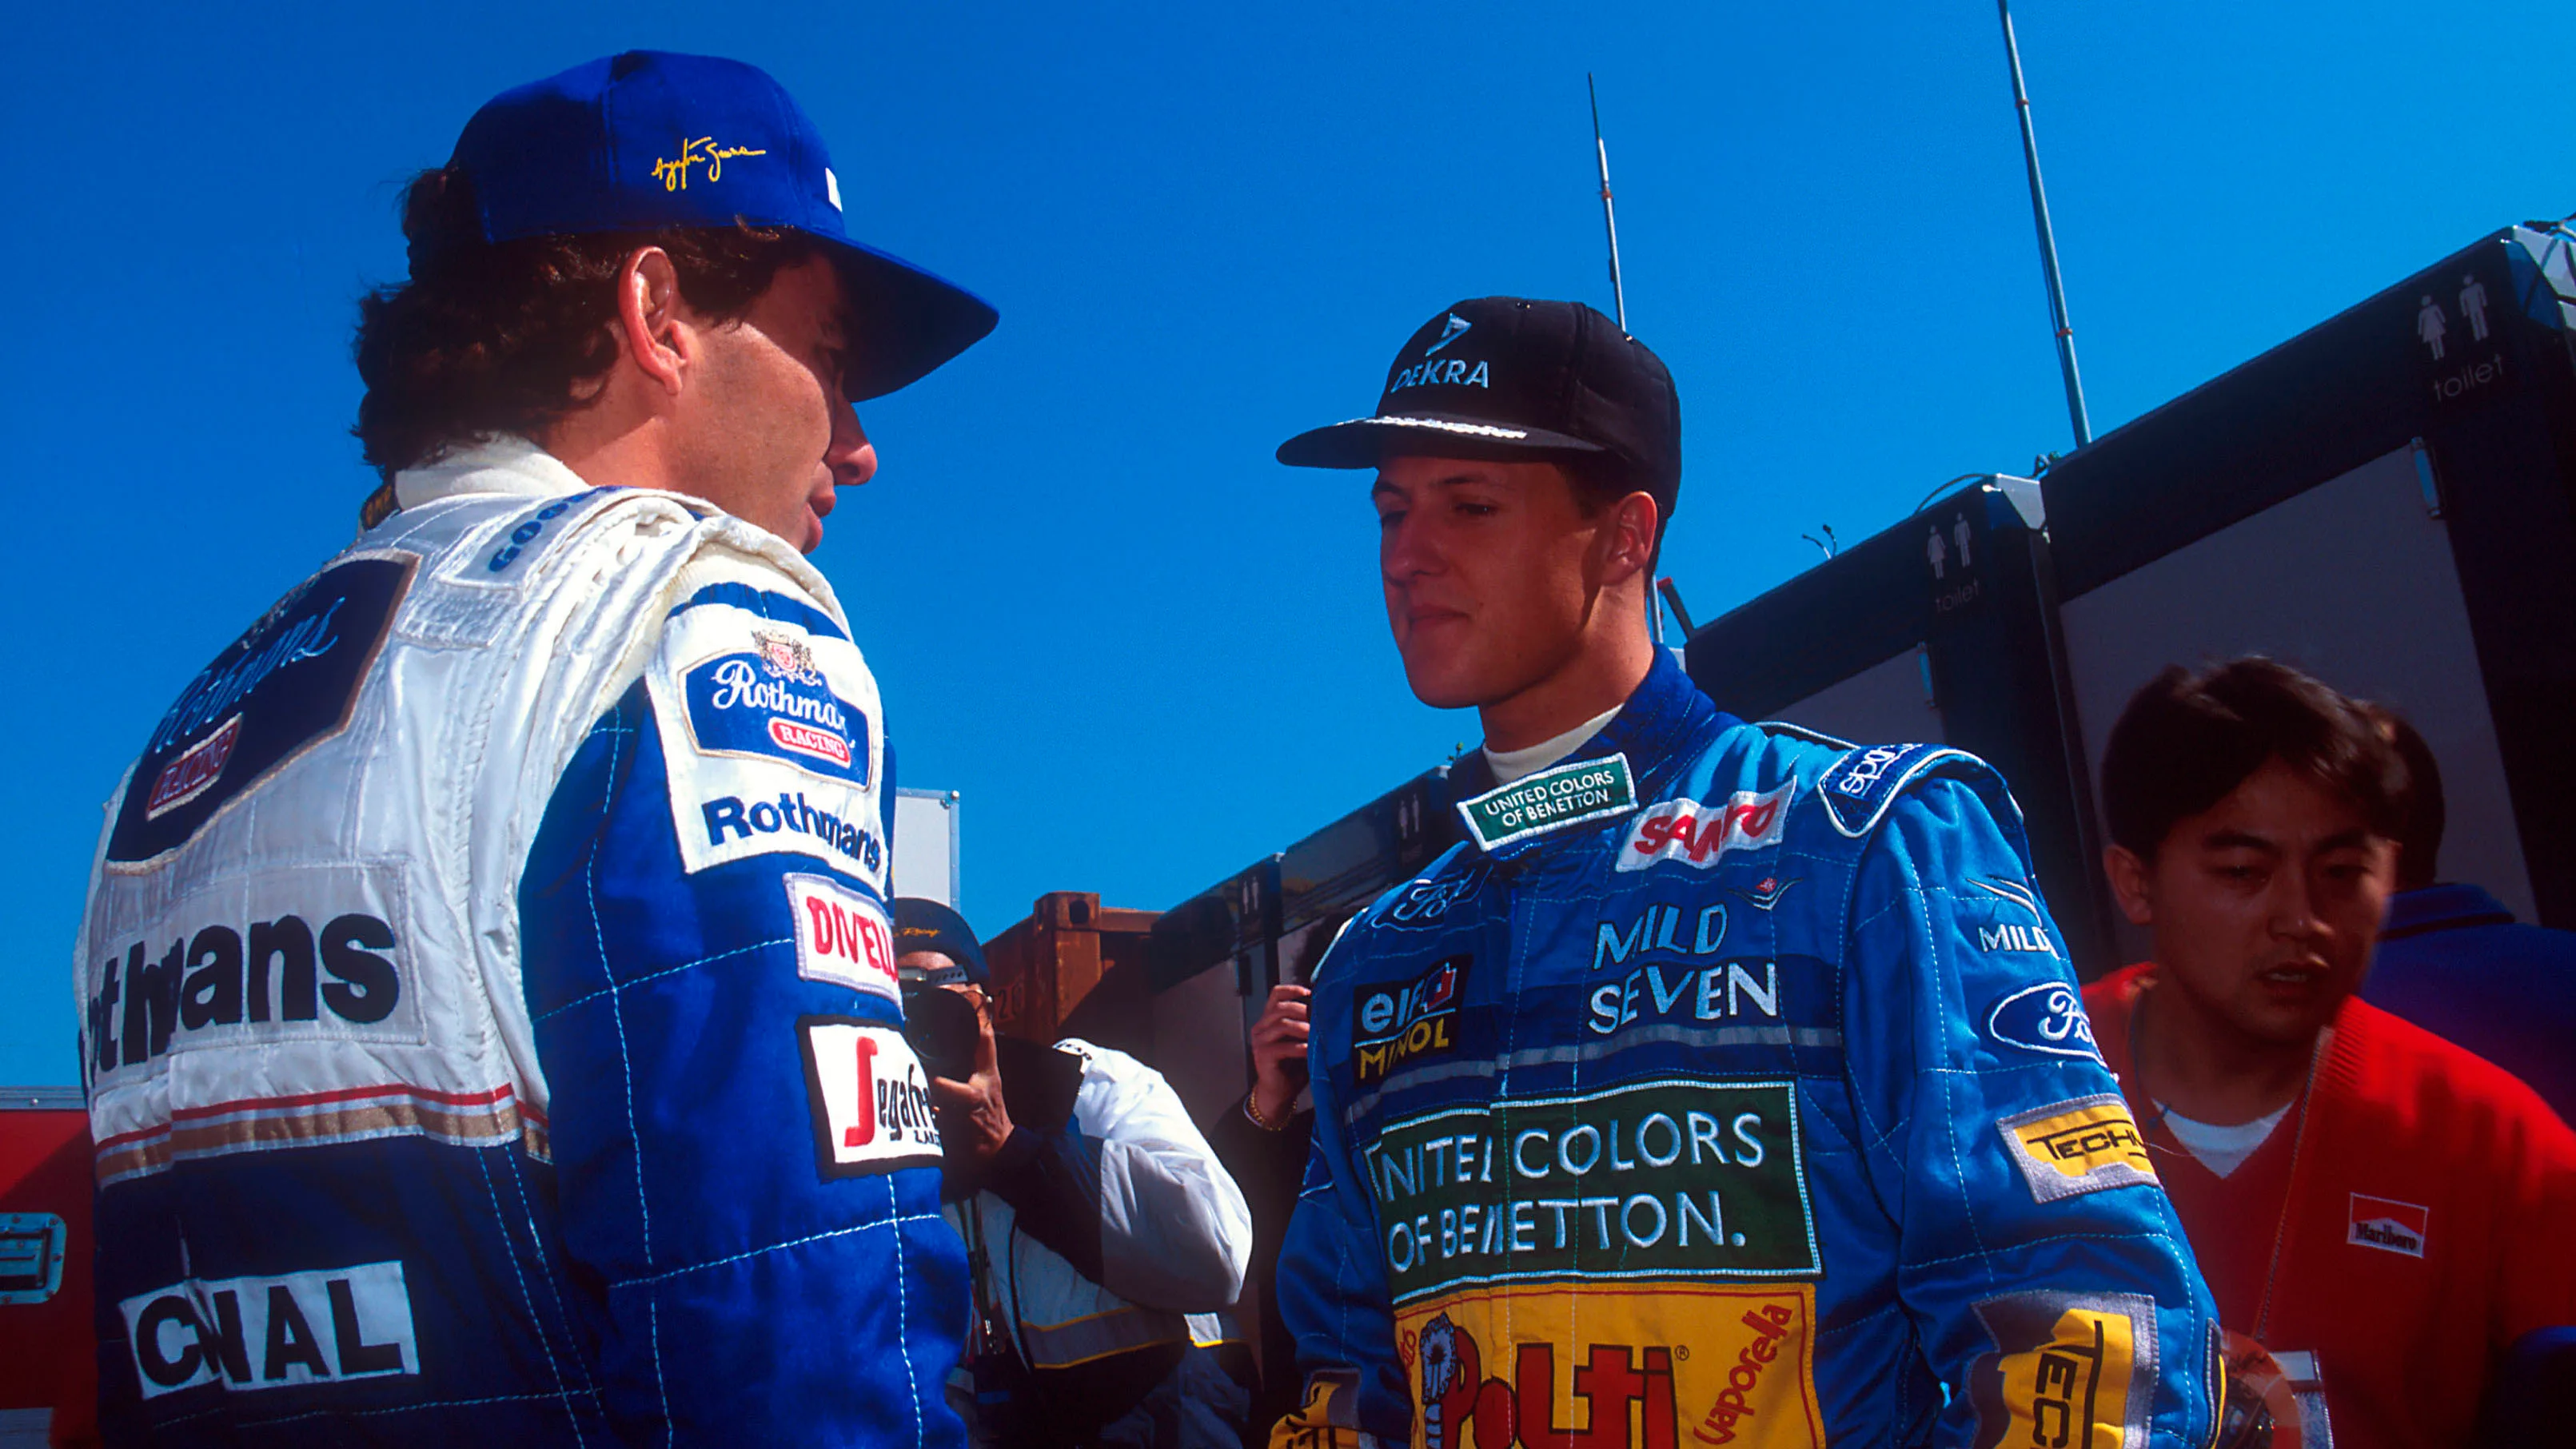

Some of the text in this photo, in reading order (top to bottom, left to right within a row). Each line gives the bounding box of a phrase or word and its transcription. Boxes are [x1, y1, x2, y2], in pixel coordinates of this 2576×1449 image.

[1390, 359, 1489, 394] DEKRA
[2434, 353, 2502, 402] toilet
[1935, 576, 1980, 614] toilet
[711, 660, 855, 749] Rothma
[779, 723, 846, 759] RACING
[1485, 770, 1614, 816] UNITED COLORS
[1840, 742, 1913, 794] spar
[701, 793, 881, 872] Rothmans
[1501, 788, 1609, 827] OF BENETTON
[1593, 903, 1728, 970] MILD
[1979, 924, 2053, 953] MILD
[1362, 979, 1425, 1037] elf
[1588, 962, 1777, 1034] SEVEN
[2038, 990, 2092, 1043] Fo
[1360, 1017, 1449, 1080] MINOL
[1381, 1113, 1764, 1202] NITE COLORS
[1388, 1214, 1433, 1272] OF
[2355, 1221, 2418, 1252] Marlboro
